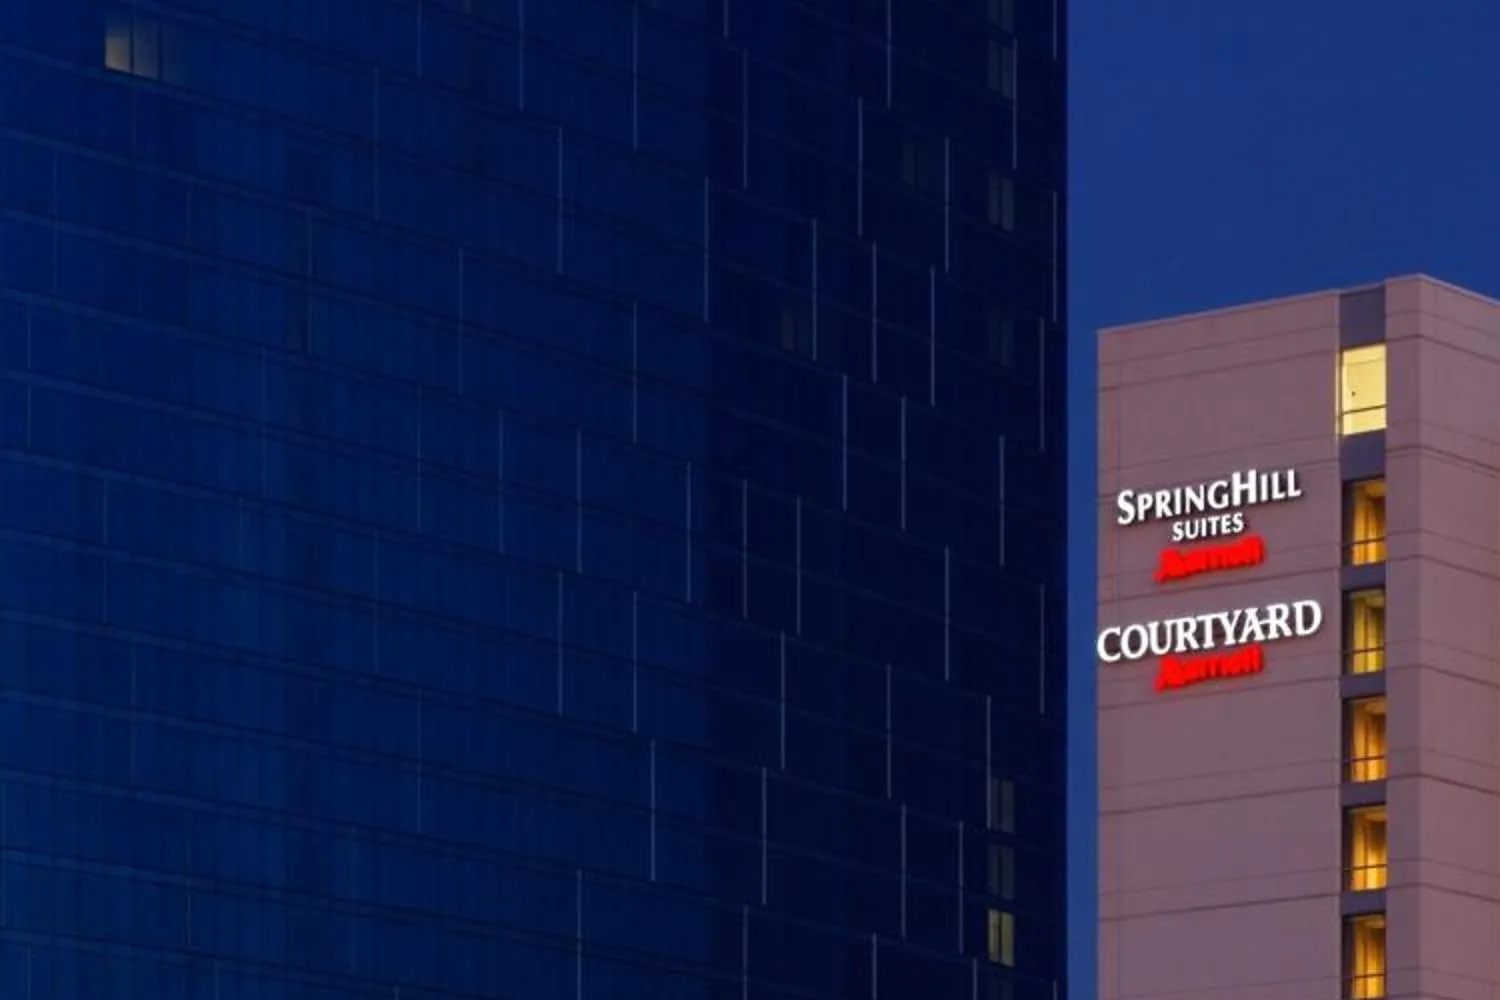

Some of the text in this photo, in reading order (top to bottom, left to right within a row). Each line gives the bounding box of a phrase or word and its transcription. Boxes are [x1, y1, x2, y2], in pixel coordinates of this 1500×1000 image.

[1117, 469, 1302, 525] SPRINGHILL
[1172, 511, 1244, 541] SUITES
[1097, 599, 1322, 662] COURTYARD
